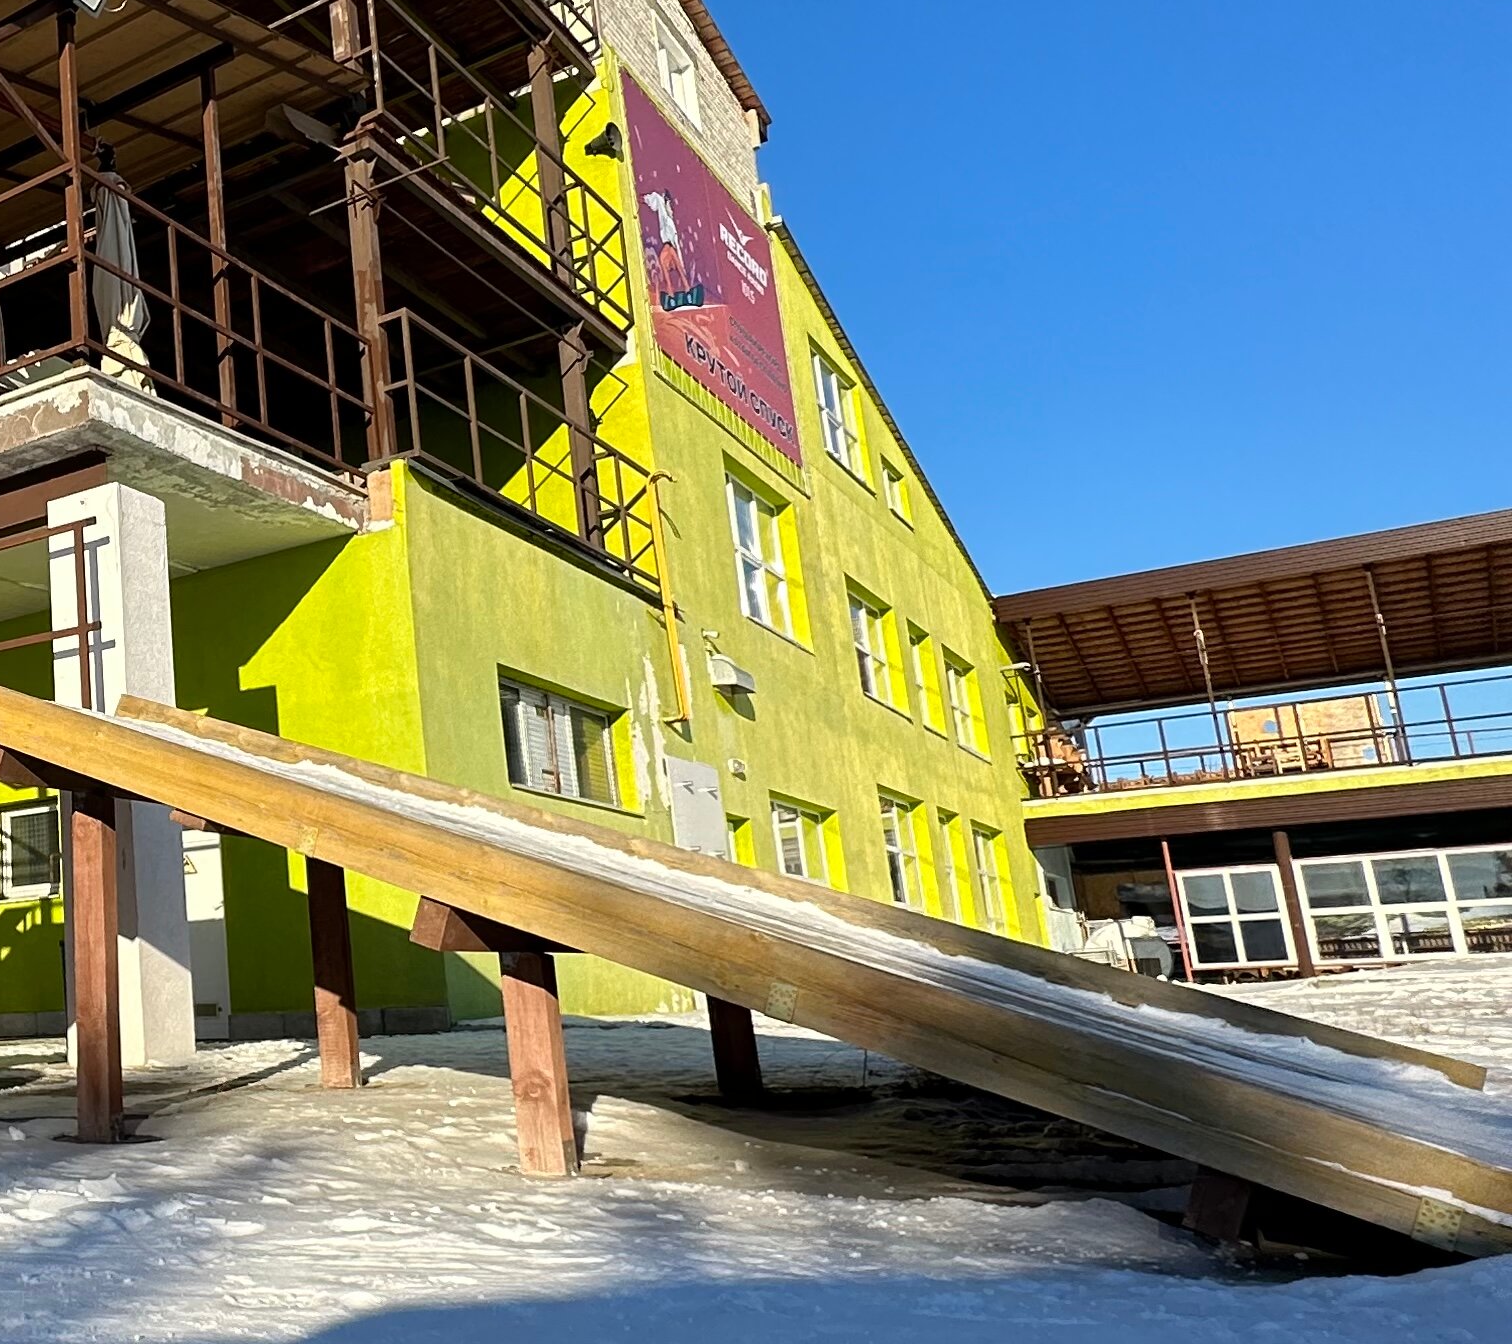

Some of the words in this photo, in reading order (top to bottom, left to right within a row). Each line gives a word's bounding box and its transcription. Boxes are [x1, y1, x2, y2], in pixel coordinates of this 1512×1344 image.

[719, 223, 768, 288] RECORD
[684, 331, 750, 407] КРУТОЙ
[749, 389, 796, 446] СПУСК
